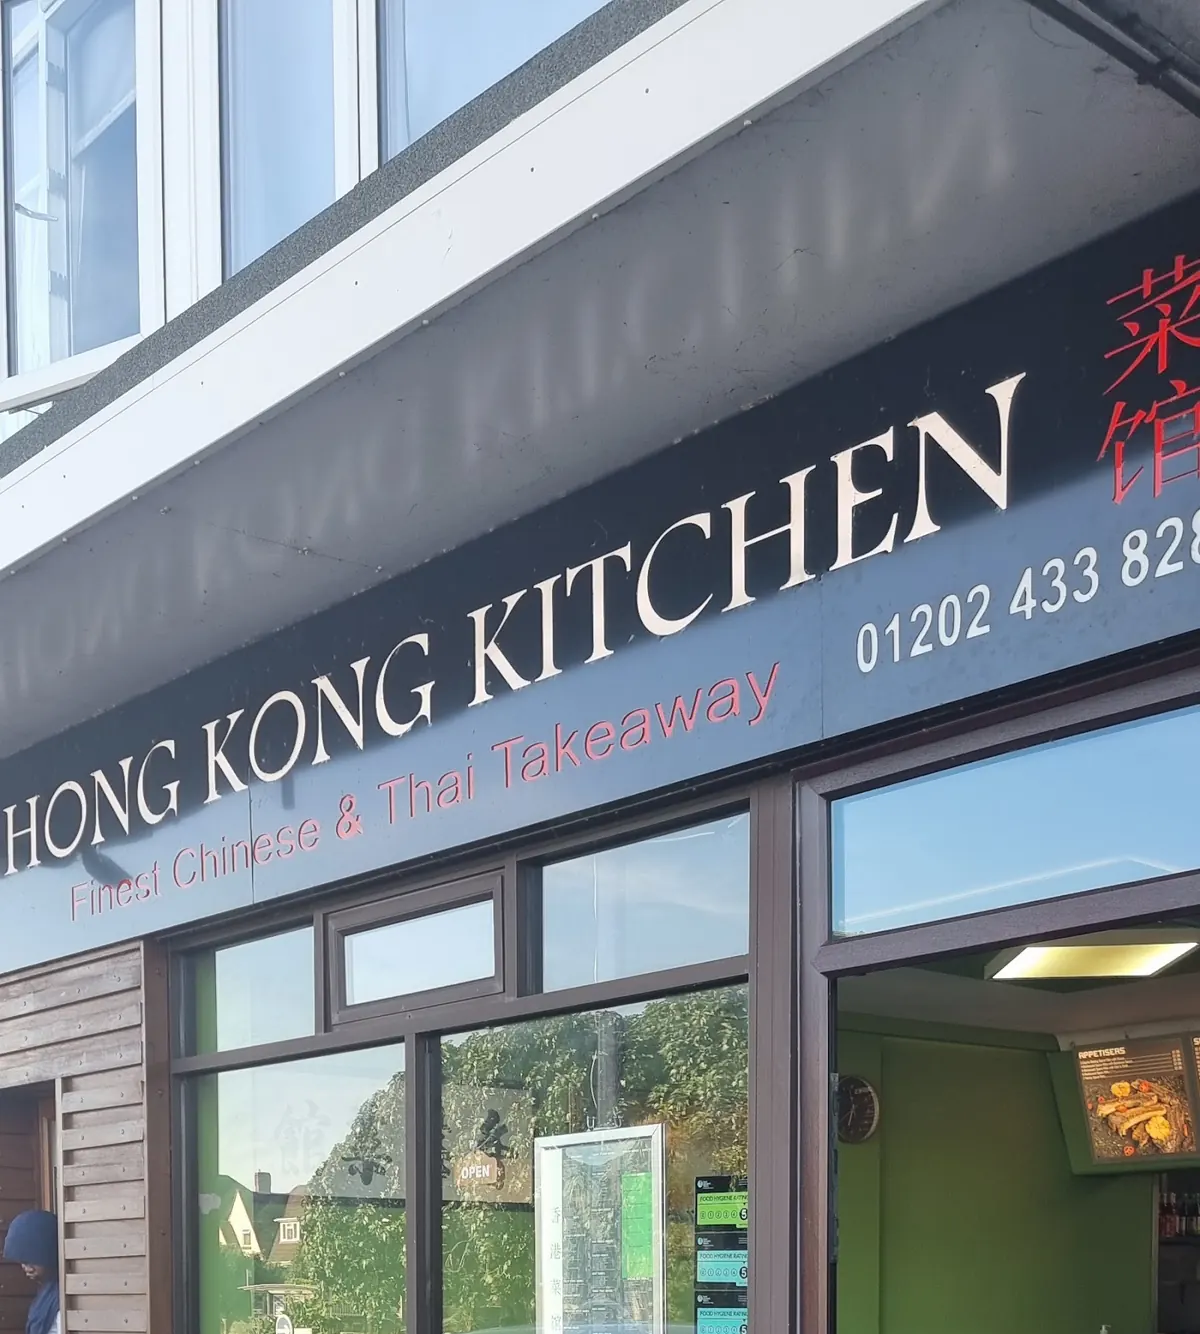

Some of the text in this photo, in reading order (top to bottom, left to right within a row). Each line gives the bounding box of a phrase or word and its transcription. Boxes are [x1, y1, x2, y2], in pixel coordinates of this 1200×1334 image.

[856, 584, 990, 673] 01202
[1009, 546, 1099, 620] 433
[3, 372, 1027, 876] HONG KONG KITCHEN
[71, 661, 781, 921] Finest Chinese & Thai Takeaway
[1078, 1047, 1126, 1059] APPETISERS
[461, 1164, 490, 1179] OPEN
[741, 1208, 747, 1219] 5
[741, 1267, 747, 1278] 5
